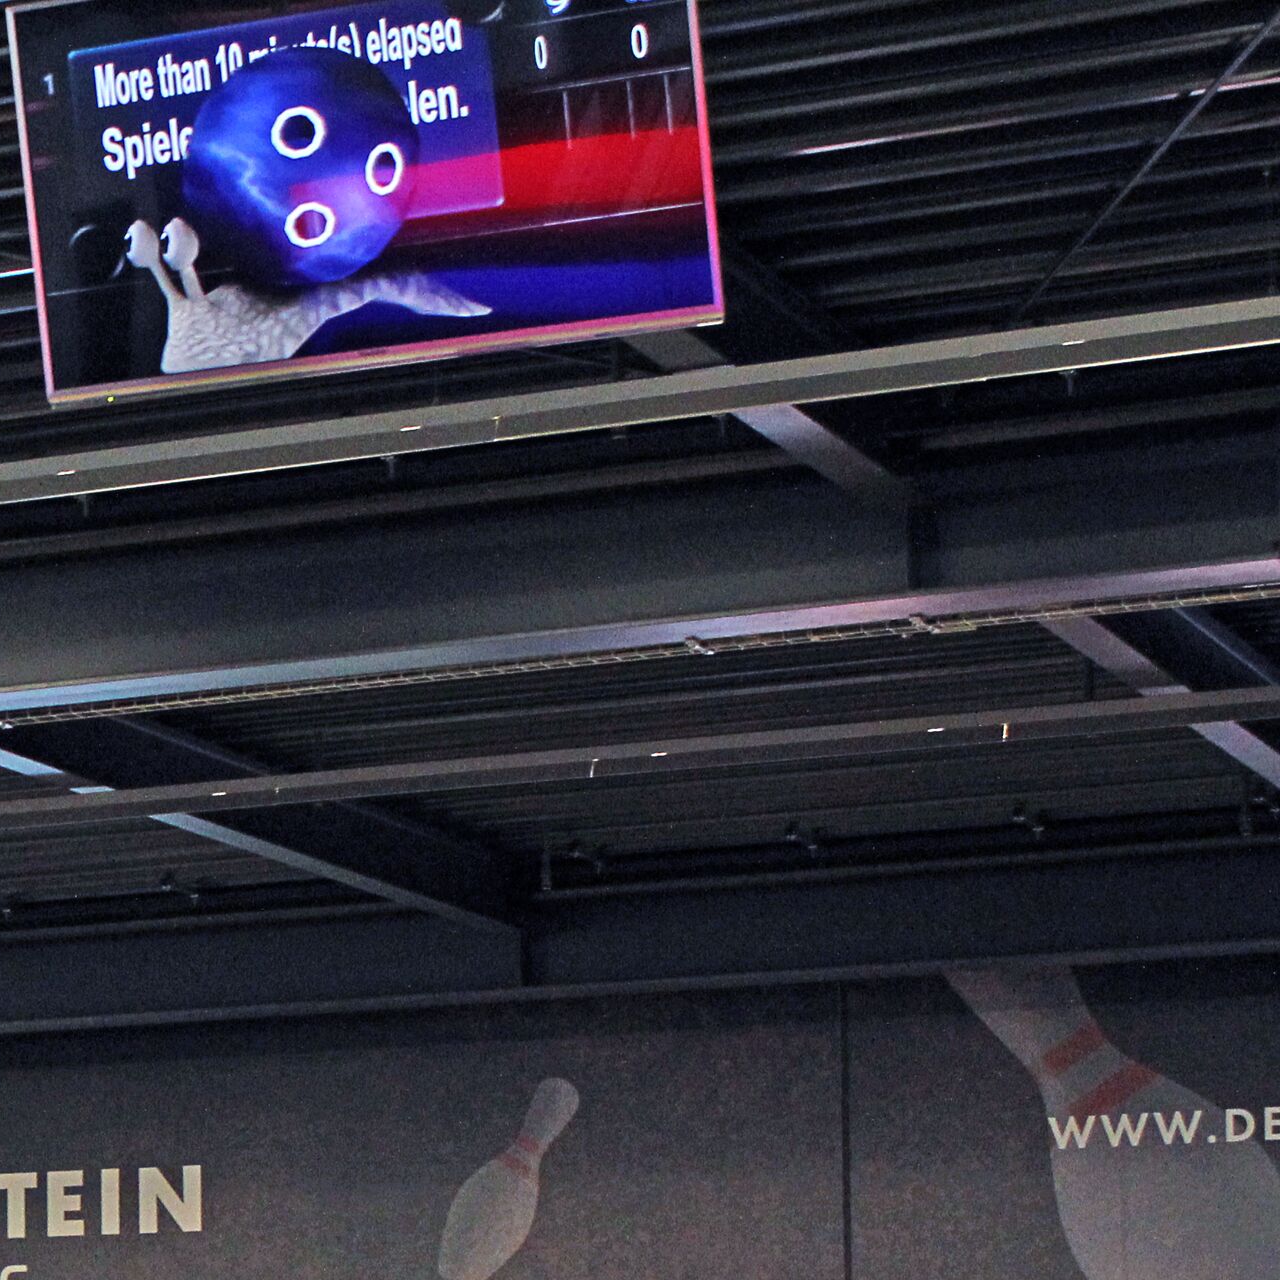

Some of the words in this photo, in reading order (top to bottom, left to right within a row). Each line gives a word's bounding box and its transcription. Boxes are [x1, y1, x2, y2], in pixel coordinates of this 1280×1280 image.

[94, 62, 154, 108] More
[157, 53, 211, 98] than
[366, 17, 463, 70] elapsed
[534, 35, 547, 69] 0
[631, 24, 648, 58] 0
[43, 73, 54, 95] 1
